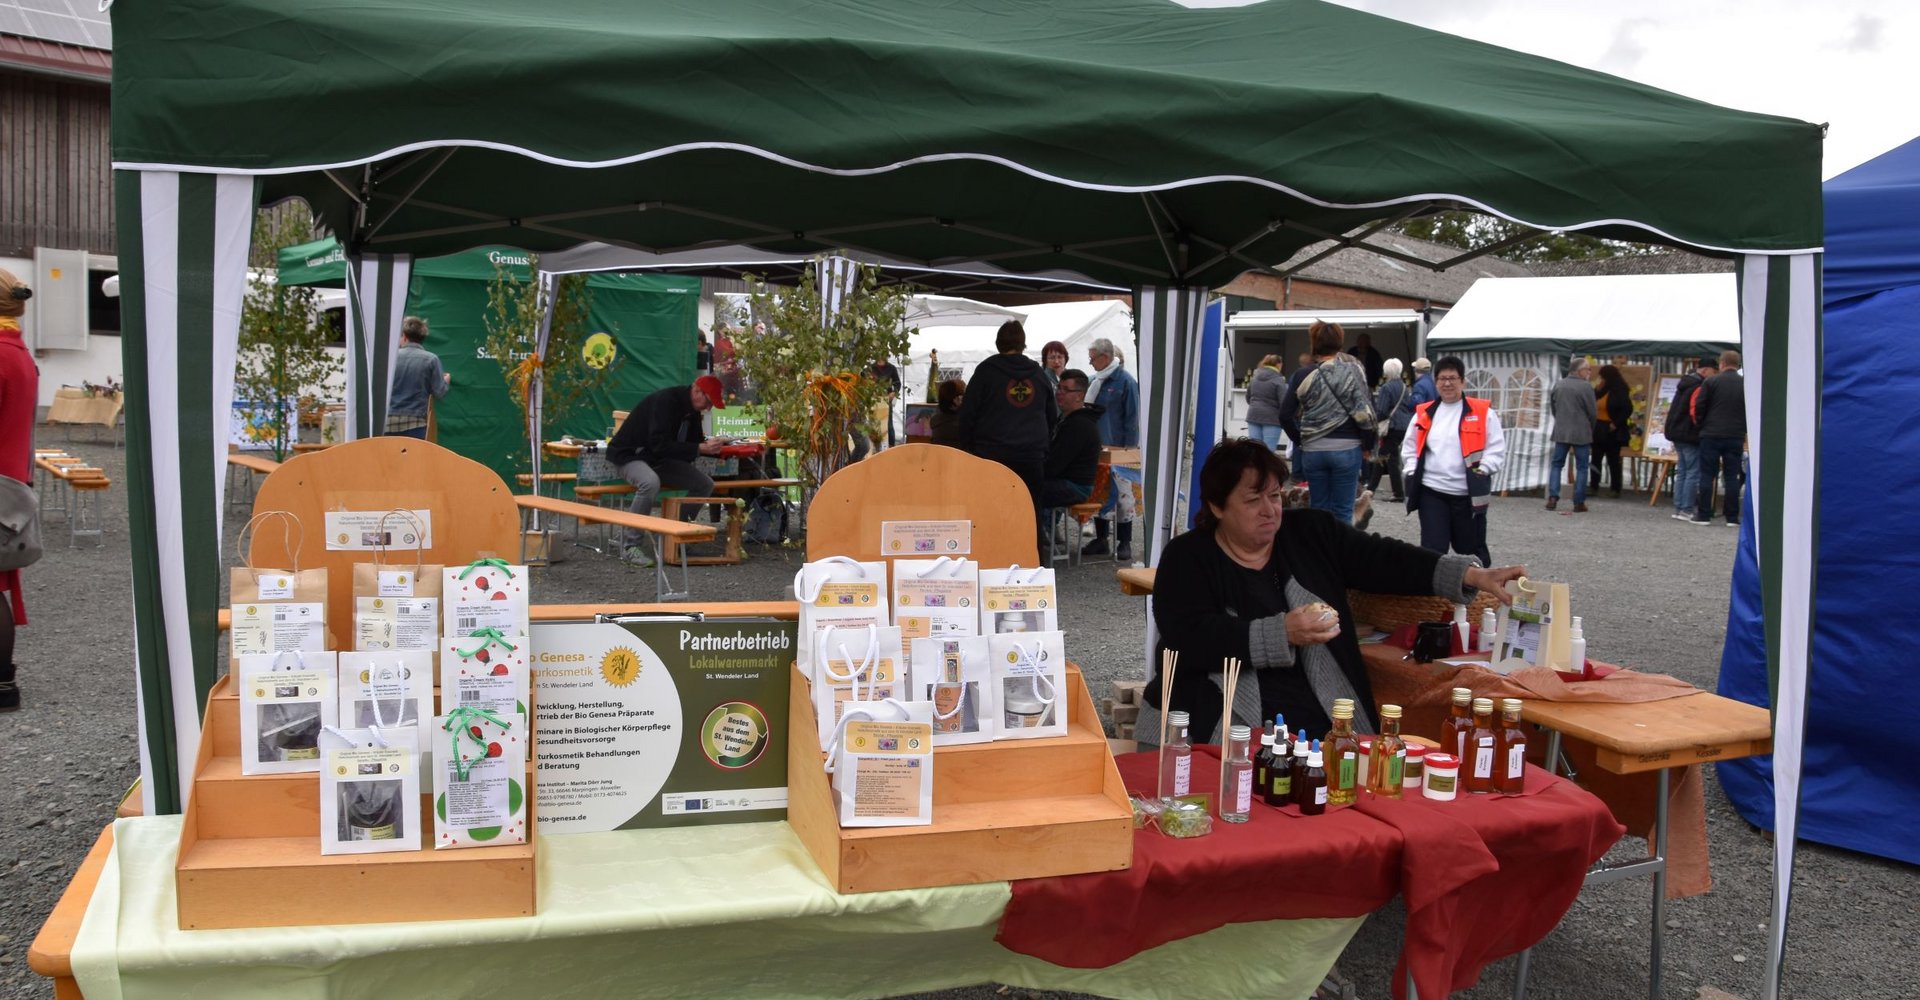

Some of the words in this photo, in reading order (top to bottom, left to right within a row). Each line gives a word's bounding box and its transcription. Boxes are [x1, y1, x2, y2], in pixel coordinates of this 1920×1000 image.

[680, 630, 790, 650] Partnerbetrieb
[540, 652, 584, 662] Genesa
[690, 654, 778, 668] Lokalwarenmarkt
[537, 666, 593, 677] urkosmetik
[537, 703, 577, 711] twicklung,
[578, 701, 624, 709] Herstellung,
[618, 710, 654, 718] Präparate
[728, 717, 749, 726] Bestes
[574, 726, 620, 735] Biologischer
[622, 724, 671, 733] Körperpflege
[714, 732, 722, 740] St.
[725, 735, 753, 746] Wendeler
[725, 744, 740, 752] Land
[1696, 748, 1722, 758] Kessler
[538, 752, 584, 760] turkosmetik
[586, 750, 640, 758] Behandlungen
[545, 762, 580, 770] Beratung
